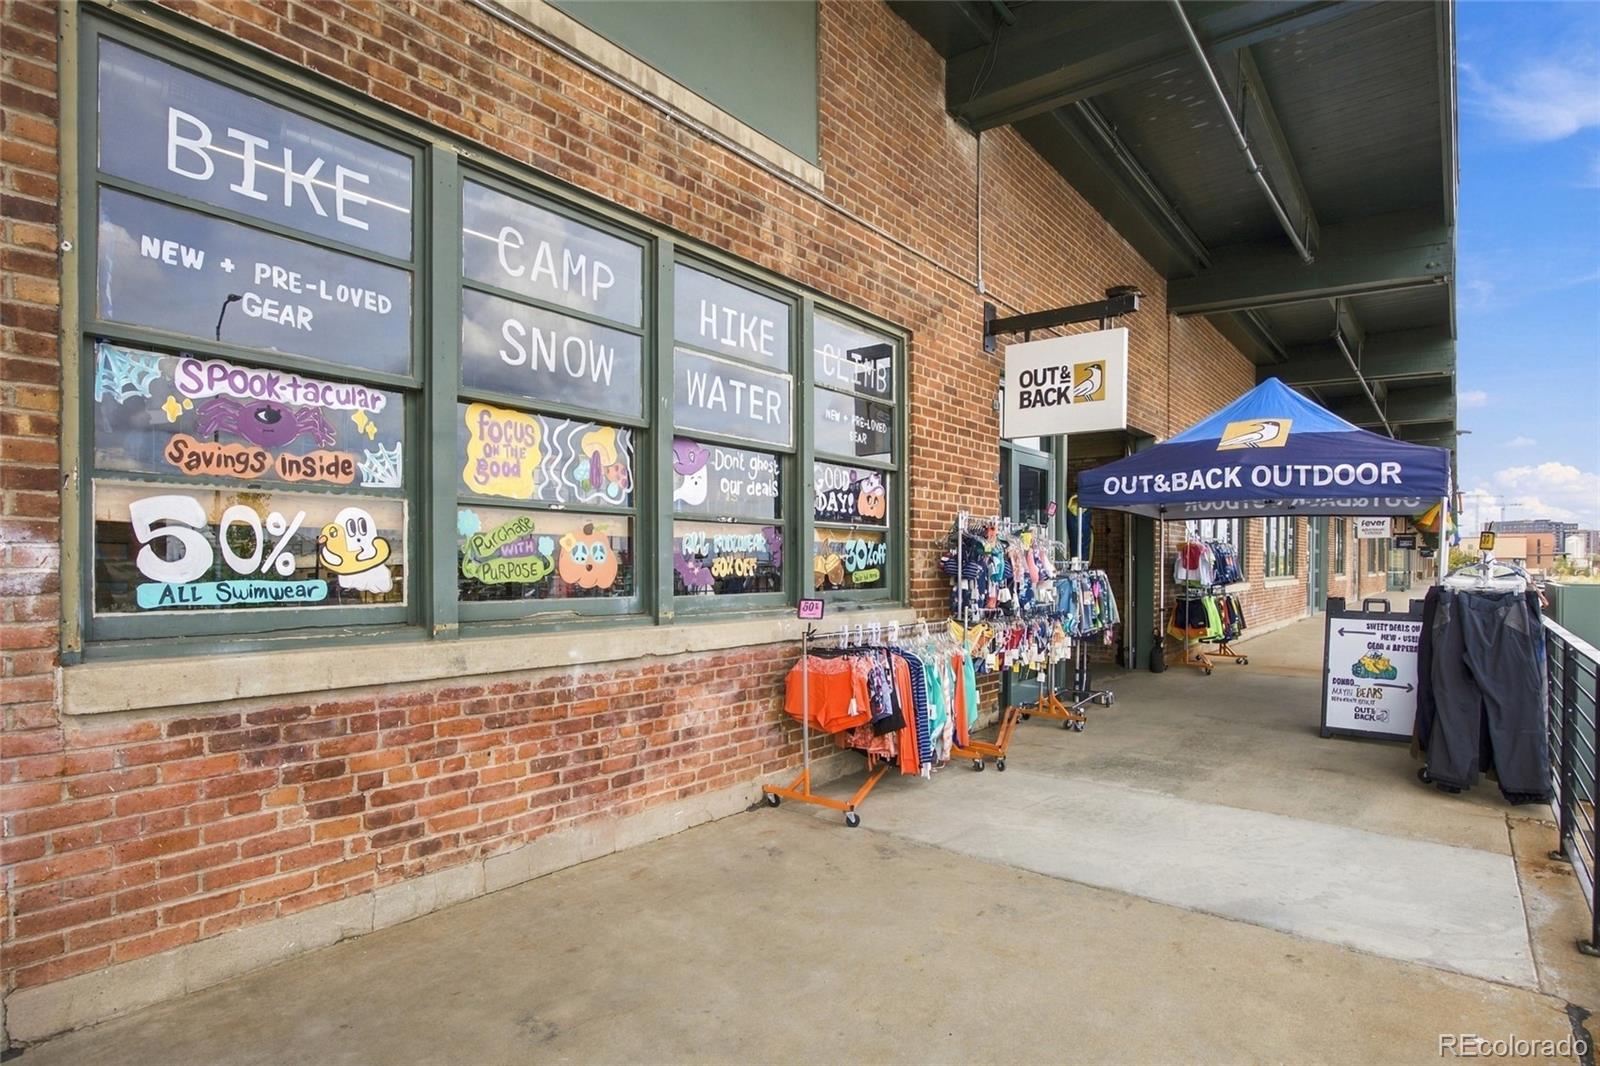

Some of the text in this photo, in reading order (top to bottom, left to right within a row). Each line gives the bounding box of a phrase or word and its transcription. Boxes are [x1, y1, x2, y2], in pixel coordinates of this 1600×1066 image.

[167, 106, 370, 231] BIKE
[141, 235, 392, 315] NEW + PRE-LOVED
[498, 225, 615, 301] CAMP
[241, 292, 313, 331] GEAR
[699, 299, 774, 357] HIKE
[499, 318, 615, 386] SNOW
[823, 343, 887, 393] CLIMB
[1019, 365, 1071, 388] OUT&
[686, 369, 781, 423] WATER
[1019, 386, 1071, 409] BACK
[825, 408, 841, 422] NEW
[168, 439, 267, 475] Savings
[714, 449, 780, 479] Don't ghost
[721, 478, 778, 497] our deals
[814, 467, 850, 491] GOOD
[1103, 461, 1402, 496] OUT&BACK OUTDOOR
[815, 492, 854, 513] DAY!
[129, 495, 305, 583] 50%
[473, 516, 535, 554] Purchase
[501, 538, 534, 556] WITH
[681, 531, 709, 556] ALL
[735, 556, 757, 577] OFF
[158, 581, 320, 604] ALL Swimwear
[1389, 624, 1409, 632] DEALS
[1356, 687, 1383, 699] BEARS
[1354, 713, 1376, 721] BACK
